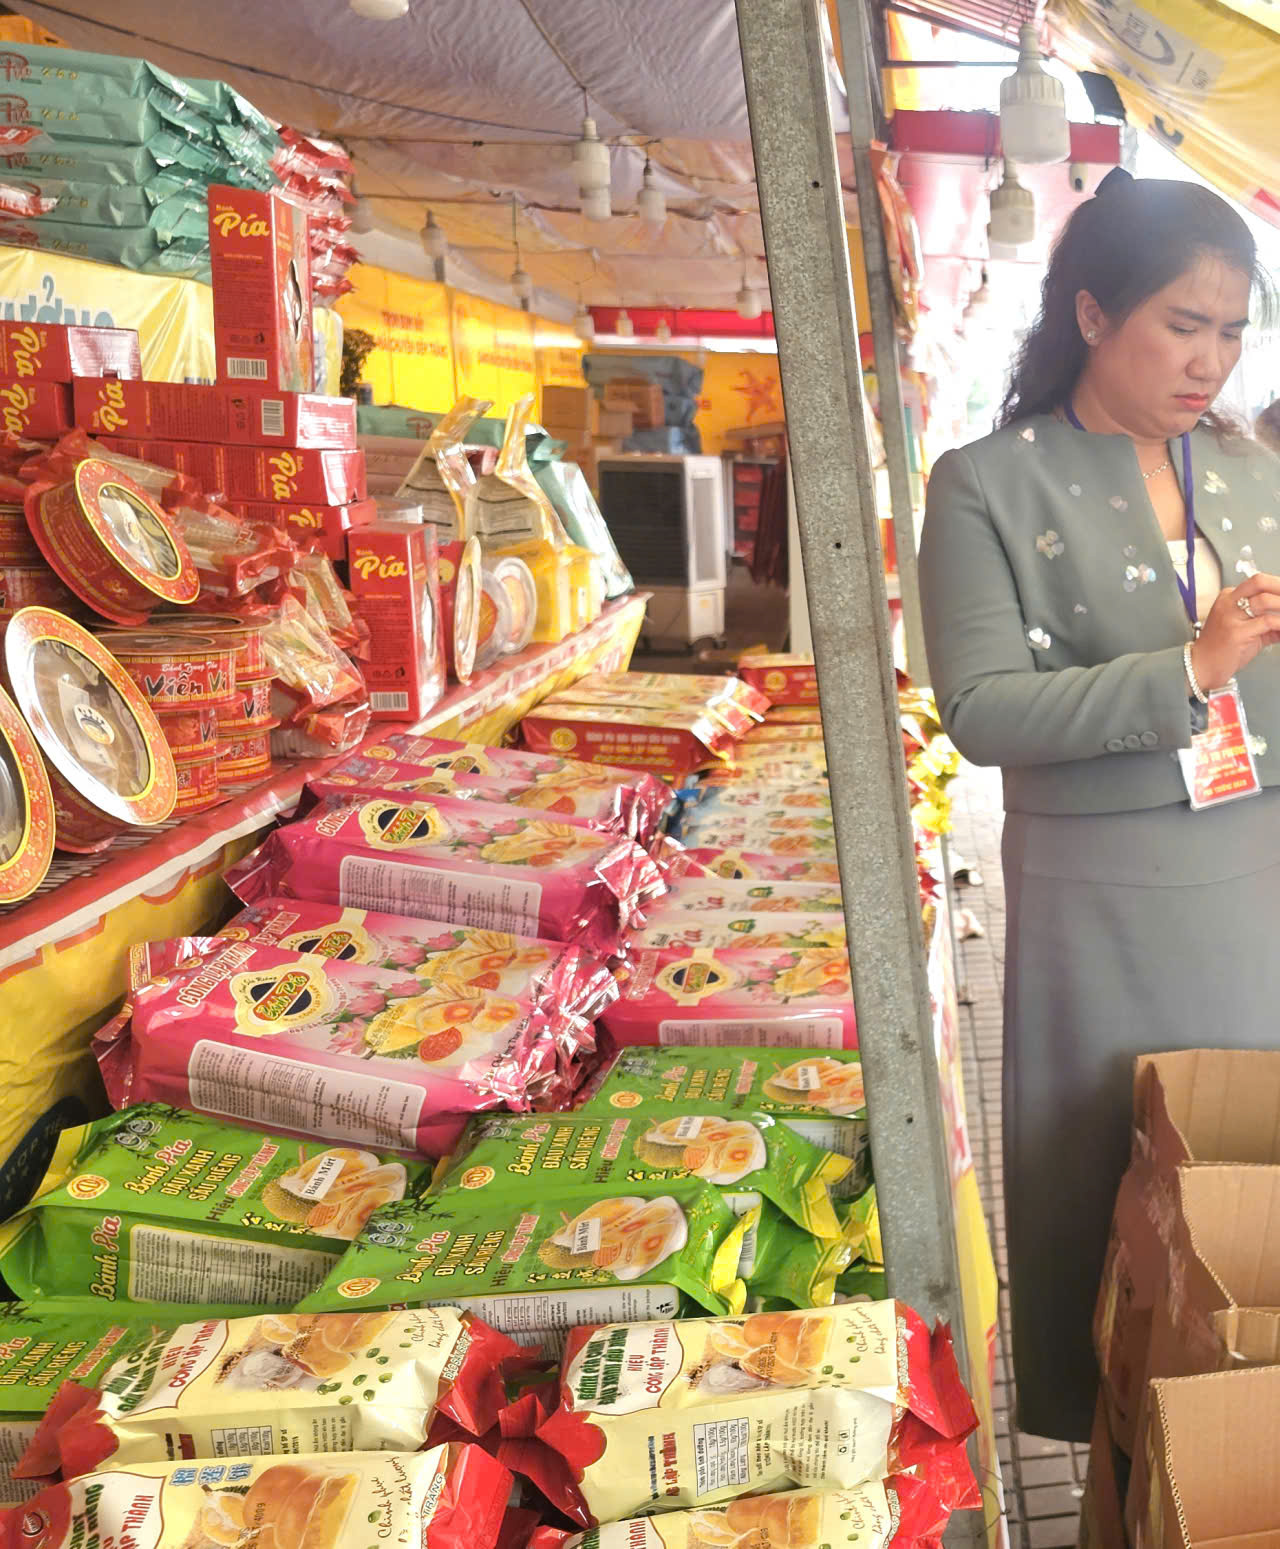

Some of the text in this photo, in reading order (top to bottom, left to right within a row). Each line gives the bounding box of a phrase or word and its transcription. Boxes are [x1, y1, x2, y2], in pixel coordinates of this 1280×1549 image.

[213, 212, 270, 238] Pía
[10, 326, 41, 377] Pía
[354, 556, 408, 579] Pía
[124, 1138, 192, 1195] Bánh Pía
[161, 1149, 216, 1197] ĐẬU XANH
[188, 1153, 242, 1202] SẦU RIÊNG
[90, 1215, 122, 1301] Bánh Pía
[23, 1341, 59, 1369] XANH
[52, 1340, 88, 1370] RIÊNG
[648, 1327, 670, 1355] THÀNH
[643, 1371, 664, 1394] CÔNG
[121, 1494, 155, 1533] THÀNH
[377, 1498, 393, 1539] Chinh
[626, 1521, 647, 1549] HÀNH
